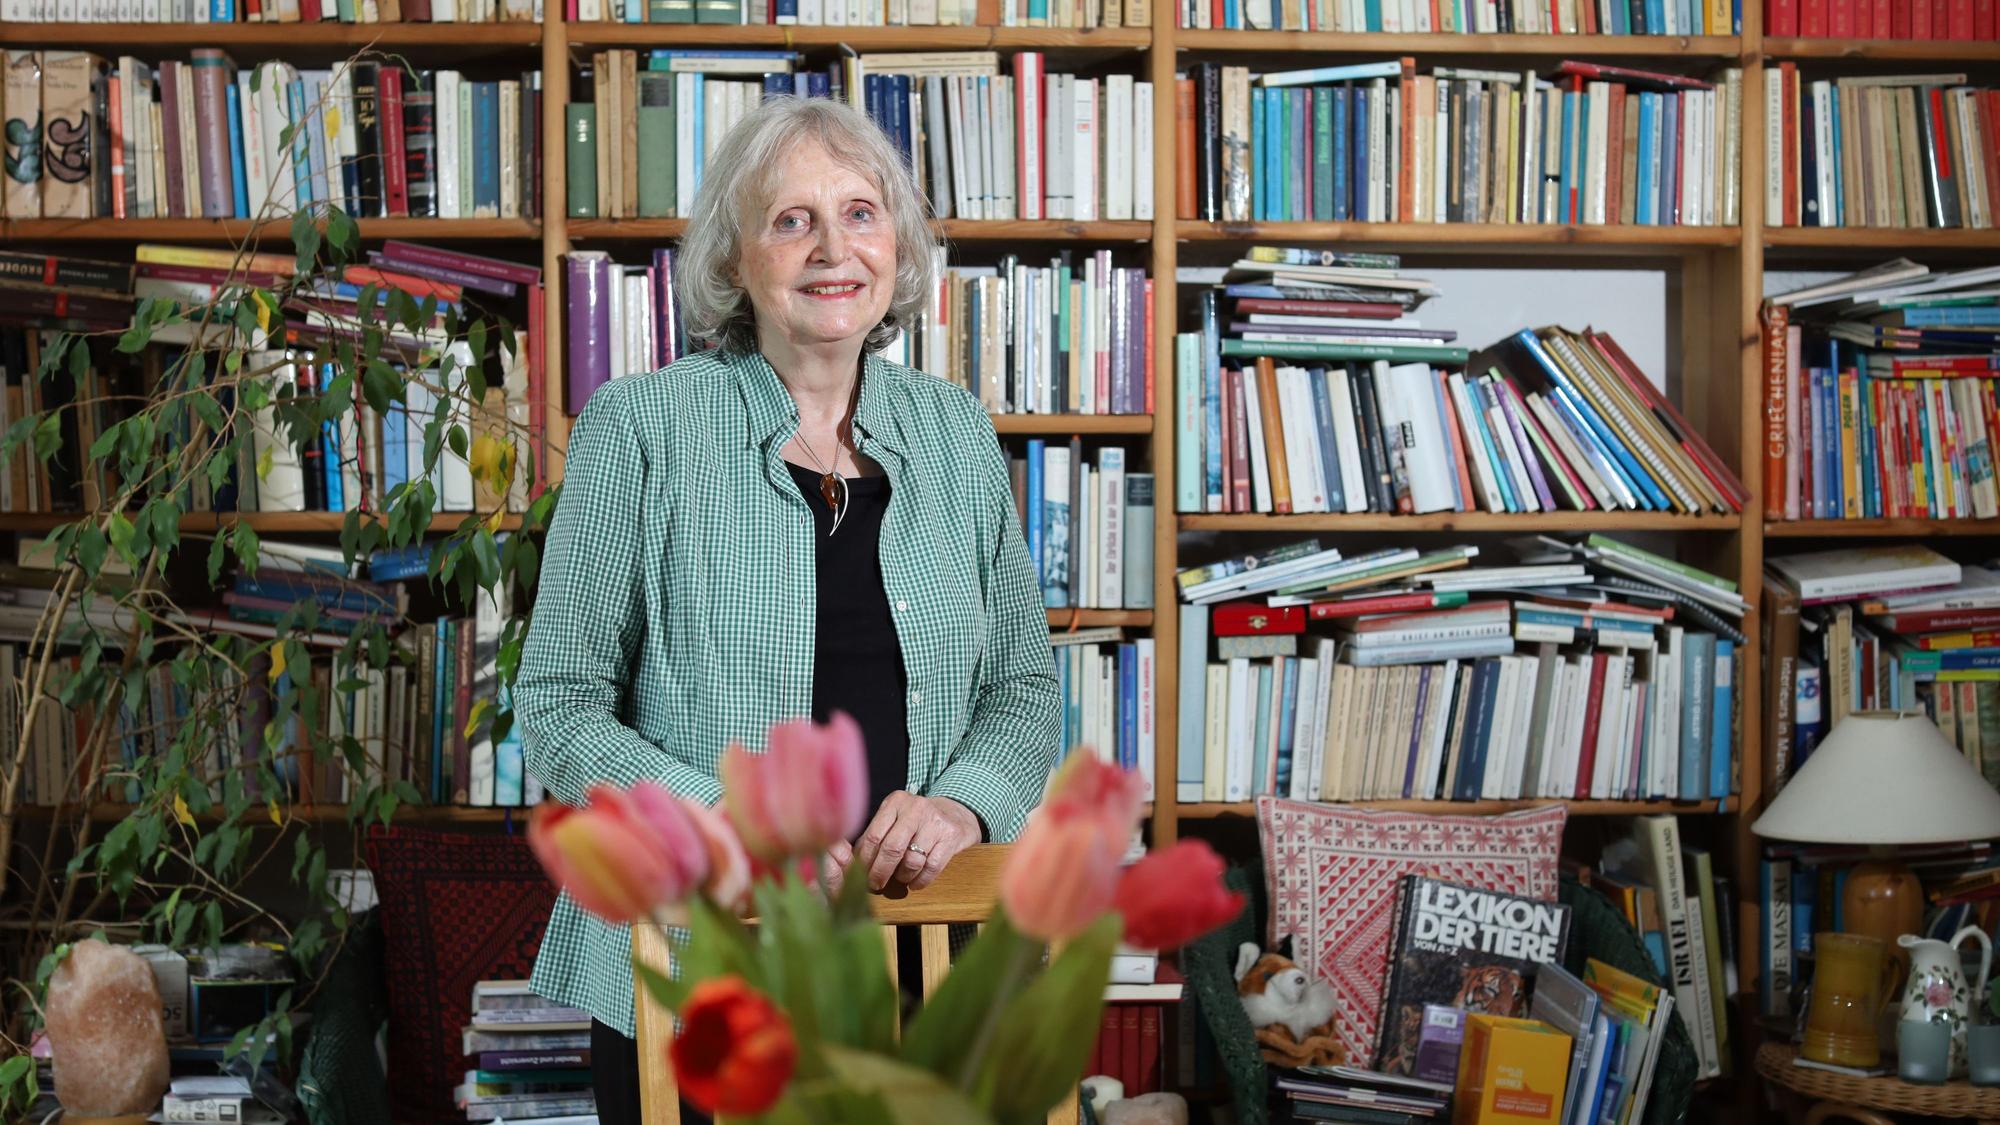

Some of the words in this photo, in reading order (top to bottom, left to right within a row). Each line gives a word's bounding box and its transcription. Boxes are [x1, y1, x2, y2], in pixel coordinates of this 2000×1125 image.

[1106, 562, 1116, 574] Der
[1433, 631, 1444, 639] AN
[1448, 629, 1471, 638] MEIN
[1474, 627, 1503, 636] LEBEN
[1693, 655, 1703, 703] LINDGREN
[1778, 657, 1793, 719] Interieurs
[1692, 705, 1701, 739] ASTRID
[1777, 721, 1788, 734] in
[1420, 883, 1563, 937] LEXIKON
[1774, 877, 1787, 950] MASSAI
[1414, 939, 1436, 952] VON
[1415, 912, 1476, 950] DER
[1480, 924, 1558, 963] TIERE
[1774, 958, 1787, 991] DIE
[500, 1056, 539, 1065] Zuversicht
[540, 1056, 553, 1064] und
[555, 1055, 582, 1064] Wandel
